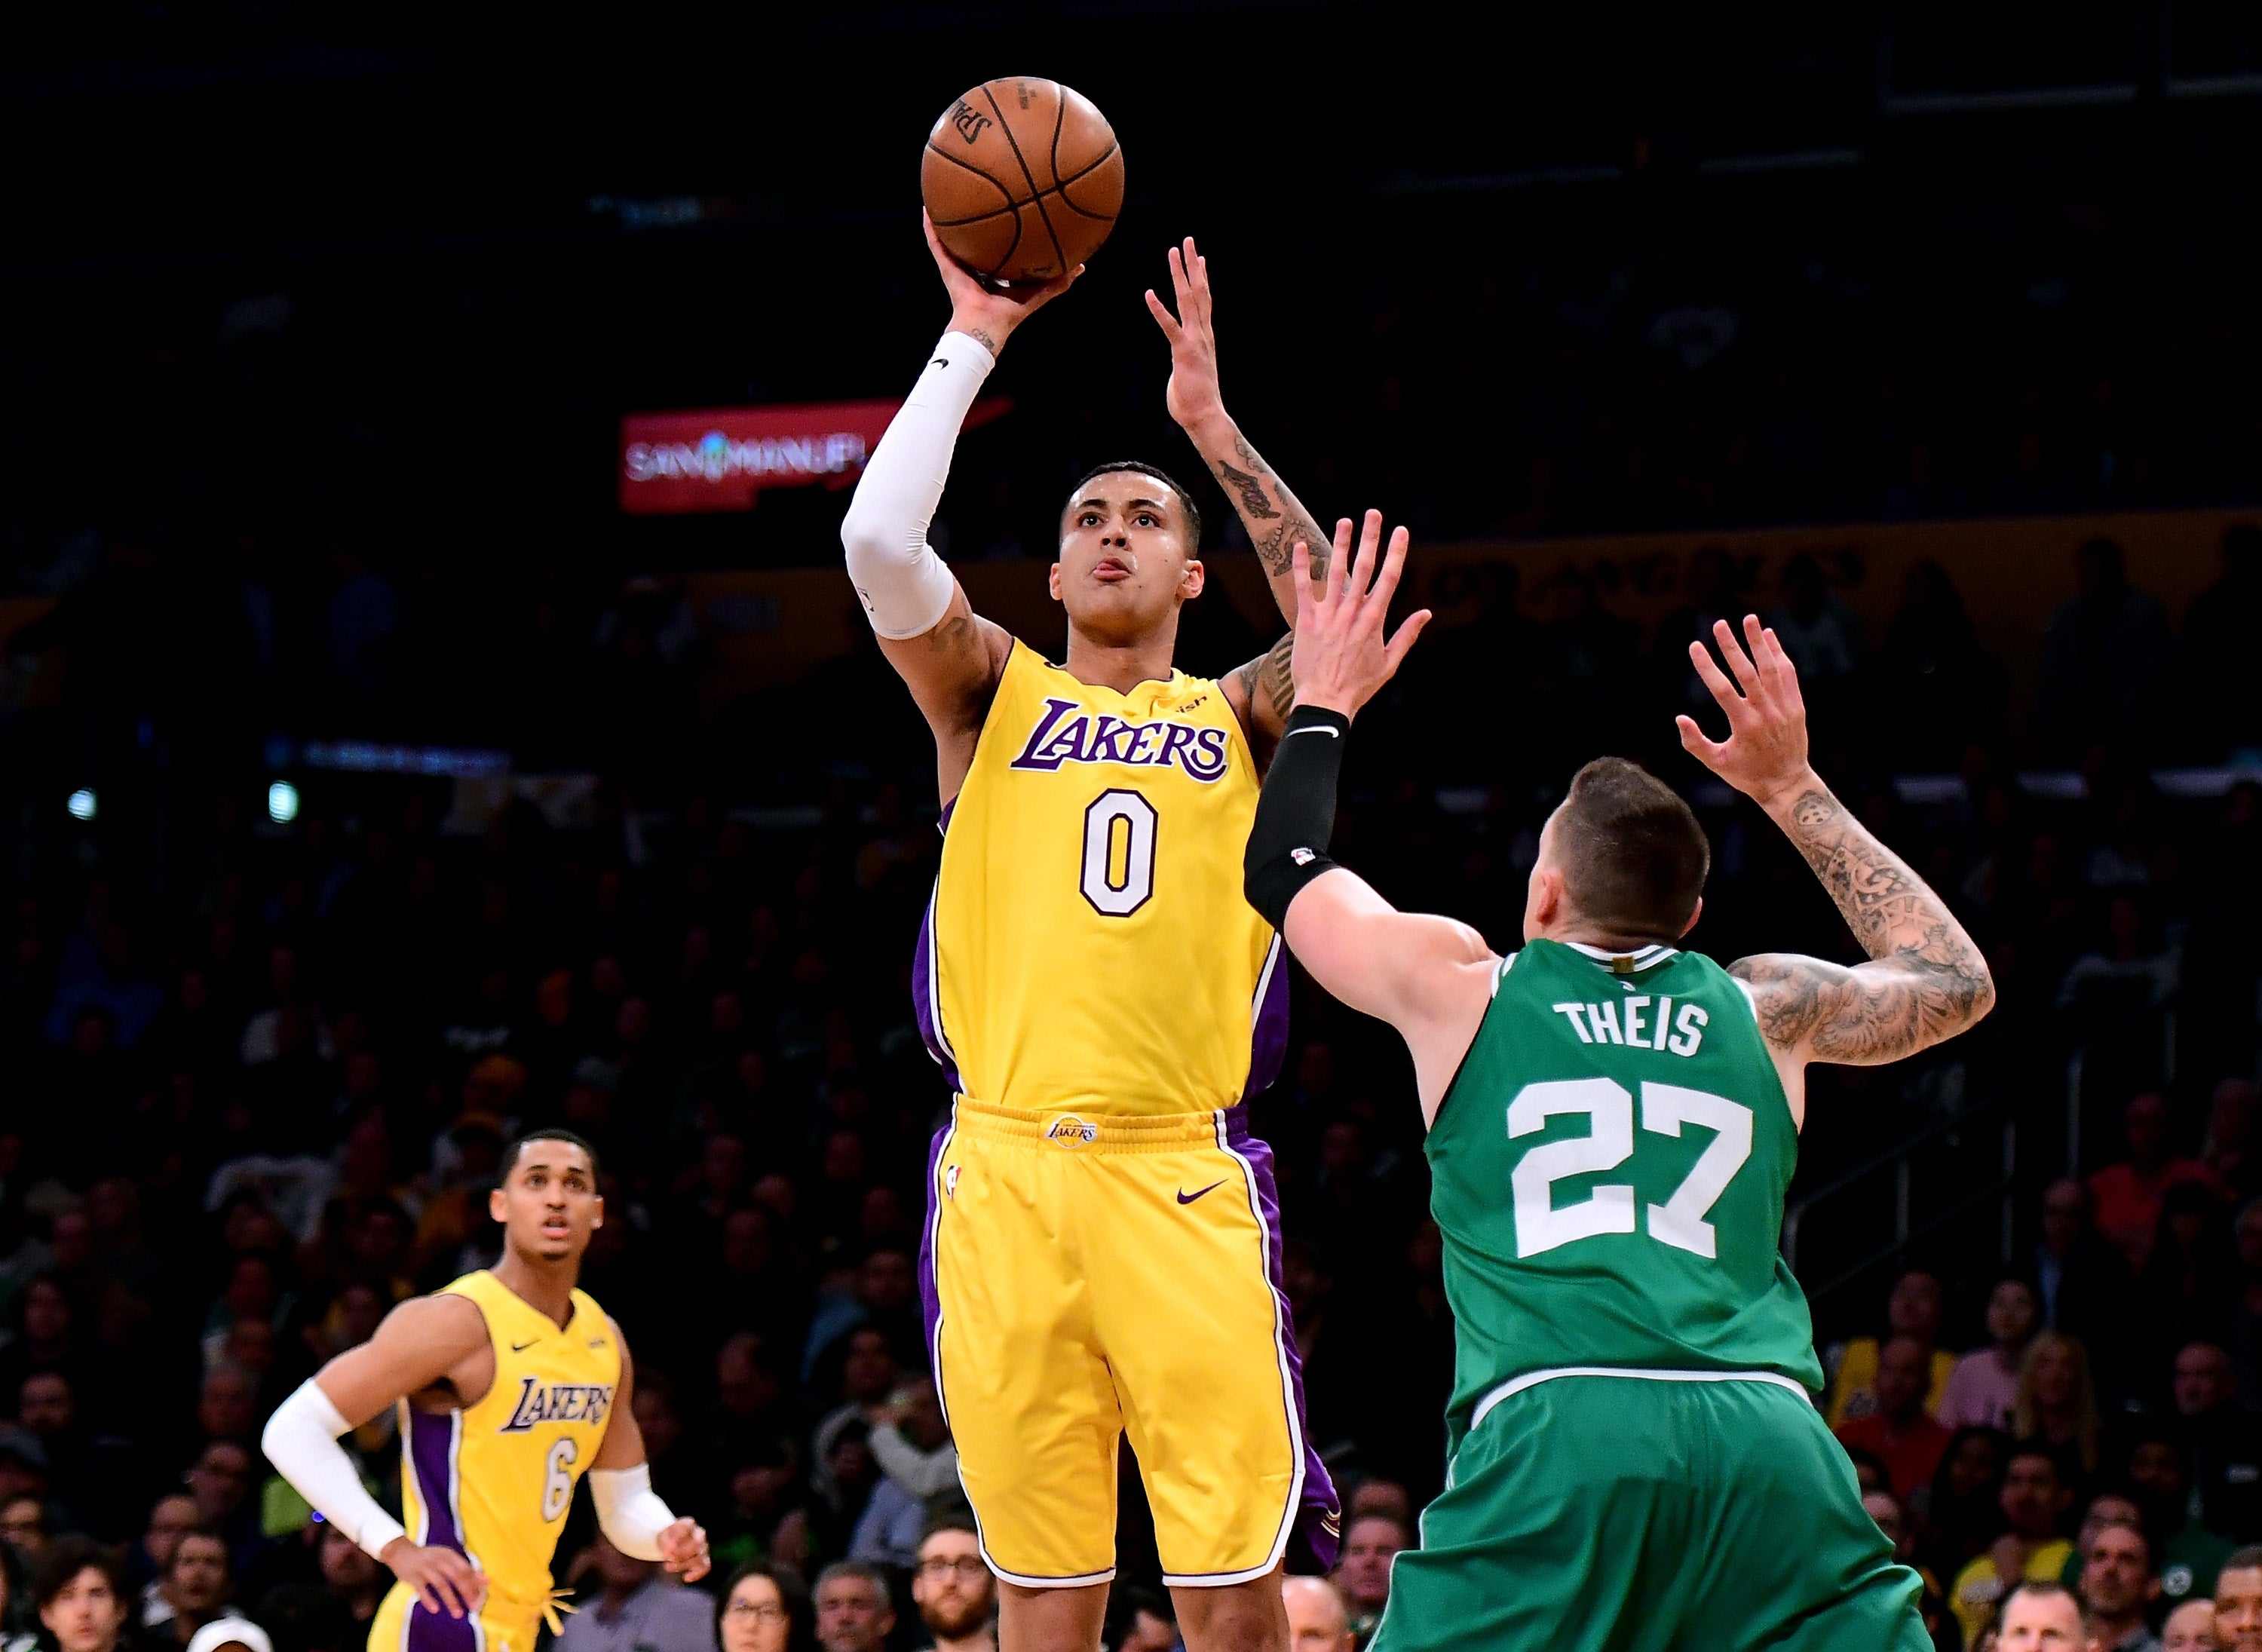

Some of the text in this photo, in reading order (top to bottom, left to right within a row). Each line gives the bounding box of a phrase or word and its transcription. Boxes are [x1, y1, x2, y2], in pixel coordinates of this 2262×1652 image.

[1010, 696, 1231, 785] LAKERS
[1079, 787, 1159, 918] 0
[1552, 995, 1709, 1058] THEIS
[1046, 1120, 1097, 1143] LAKERS
[1506, 1076, 1754, 1259] 27
[541, 1436, 579, 1524] 6
